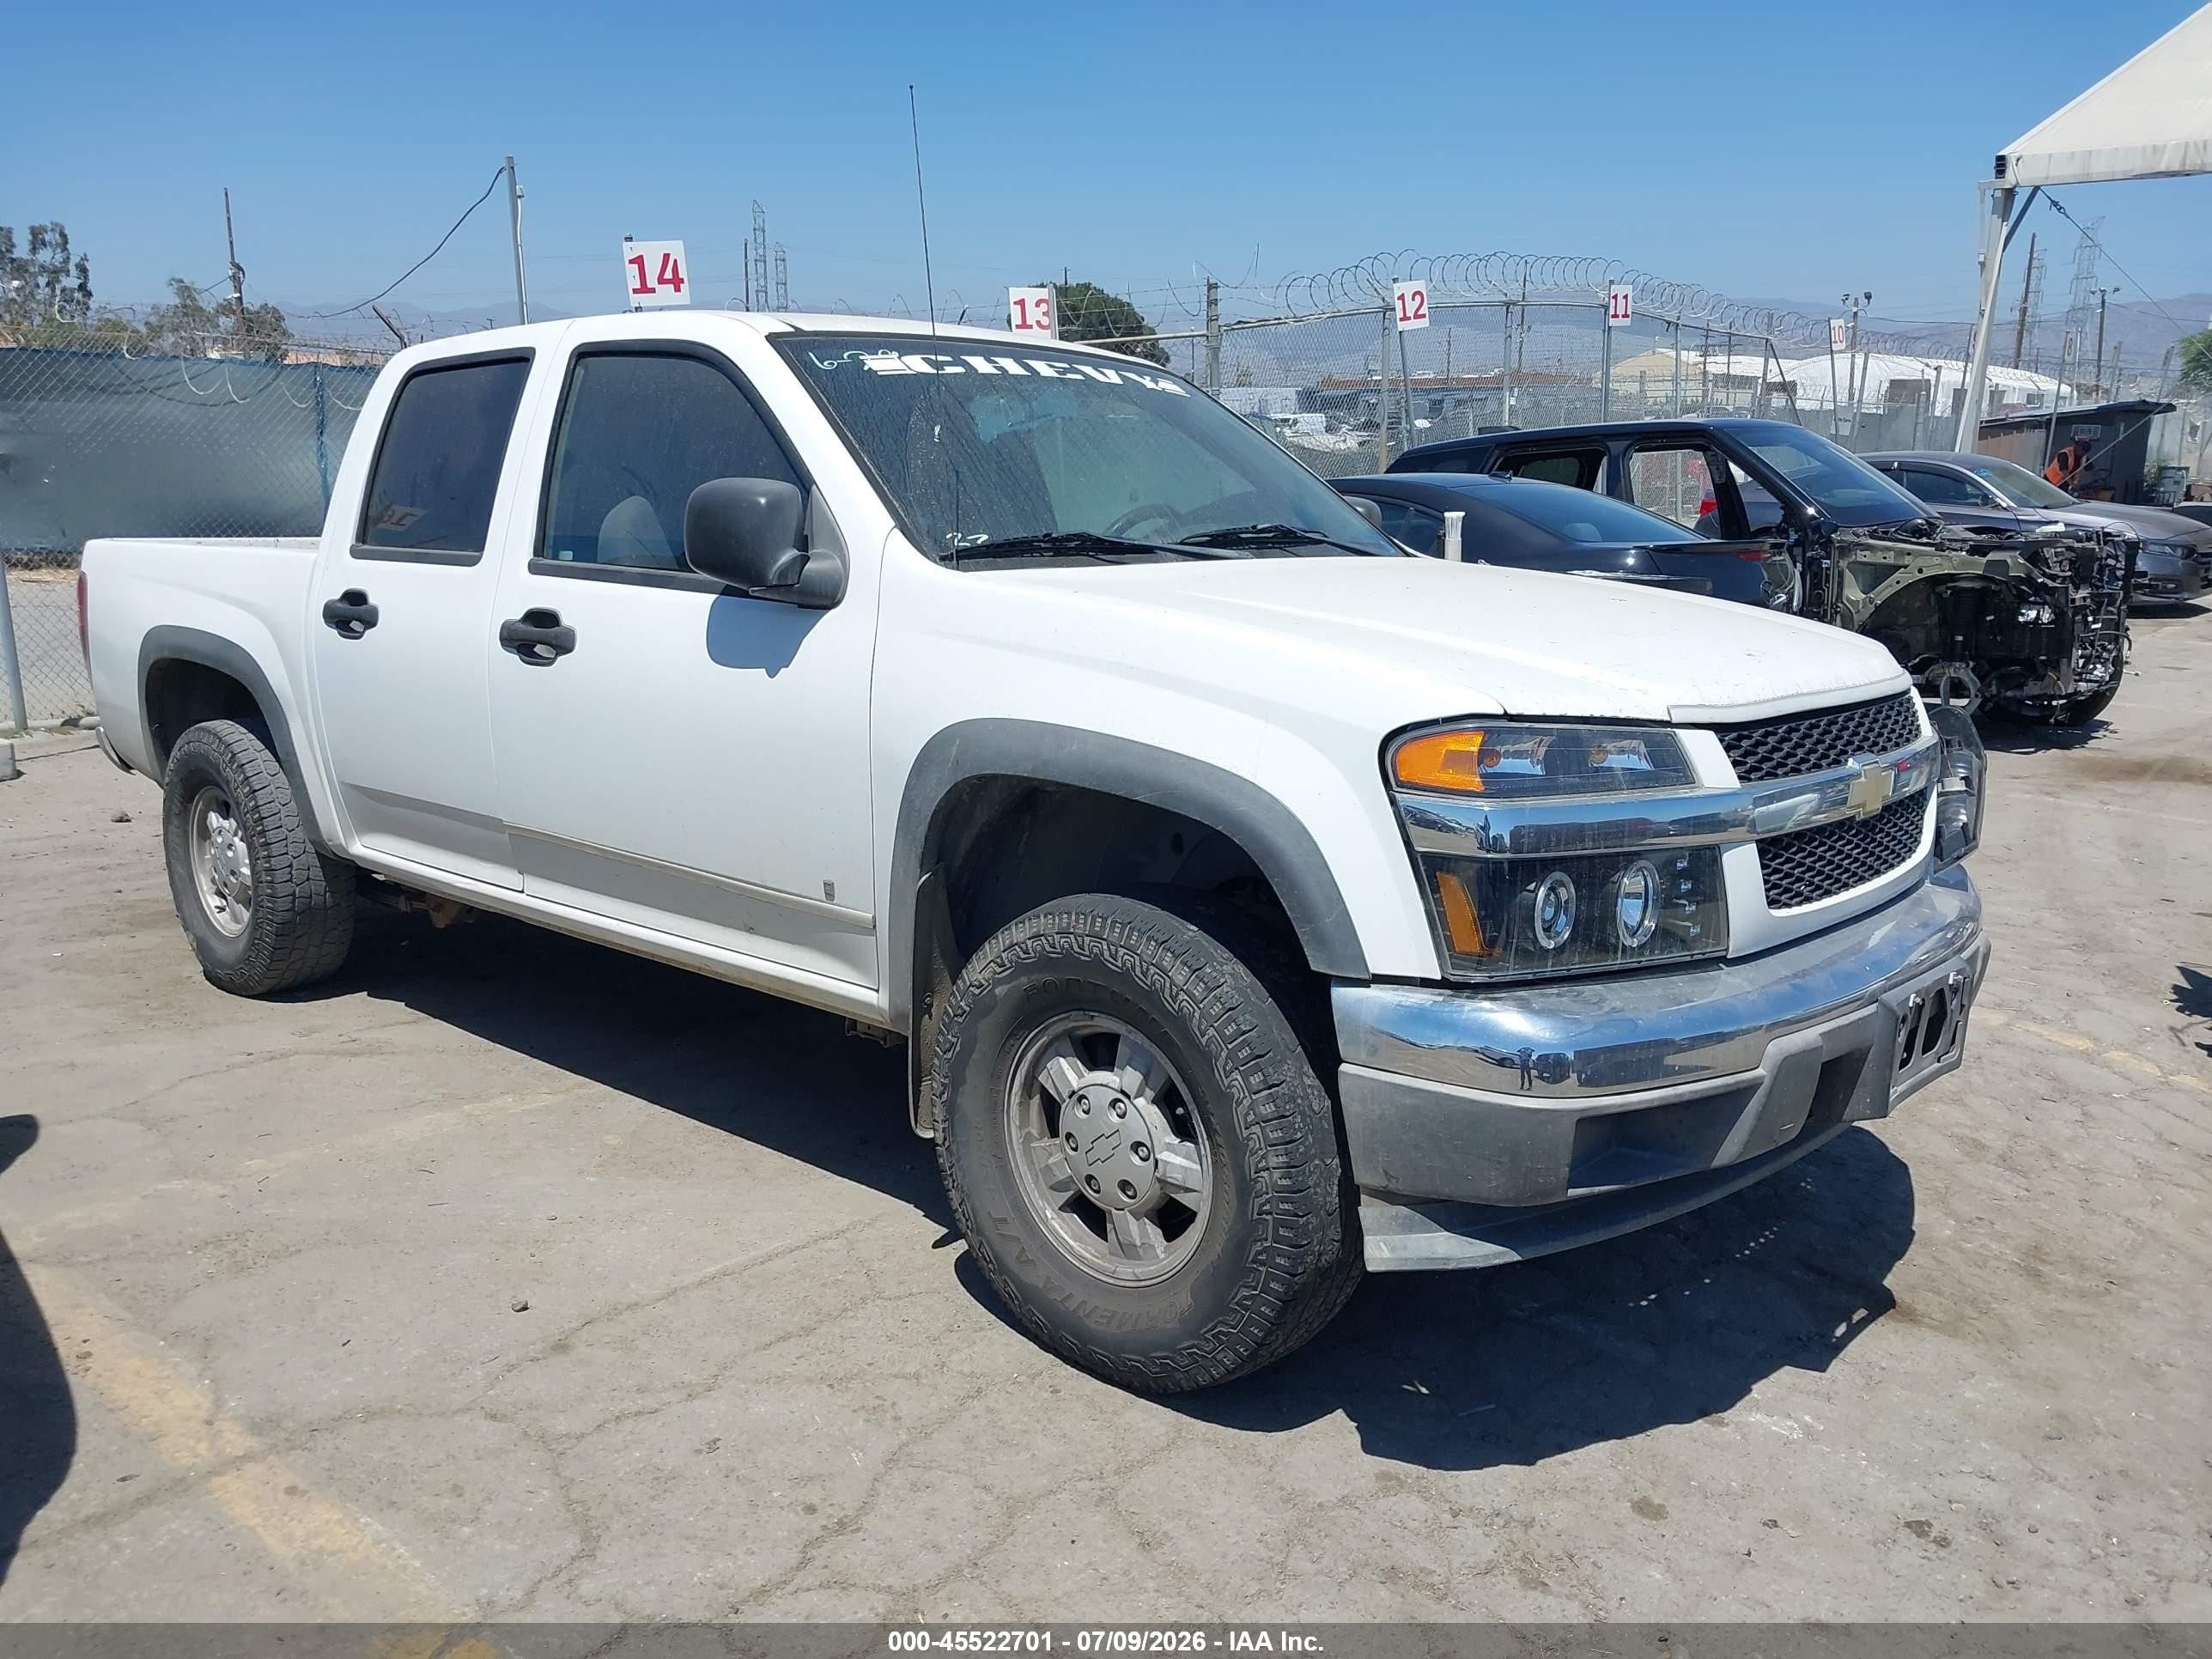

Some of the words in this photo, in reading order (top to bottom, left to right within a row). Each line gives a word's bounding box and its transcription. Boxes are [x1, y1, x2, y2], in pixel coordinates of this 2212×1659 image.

[629, 252, 684, 294] 14
[1012, 297, 1051, 331] 13
[1396, 289, 1427, 322] 12
[1611, 293, 1630, 319] 11
[1832, 325, 1844, 344] 10
[908, 354, 1170, 391] CHEVY
